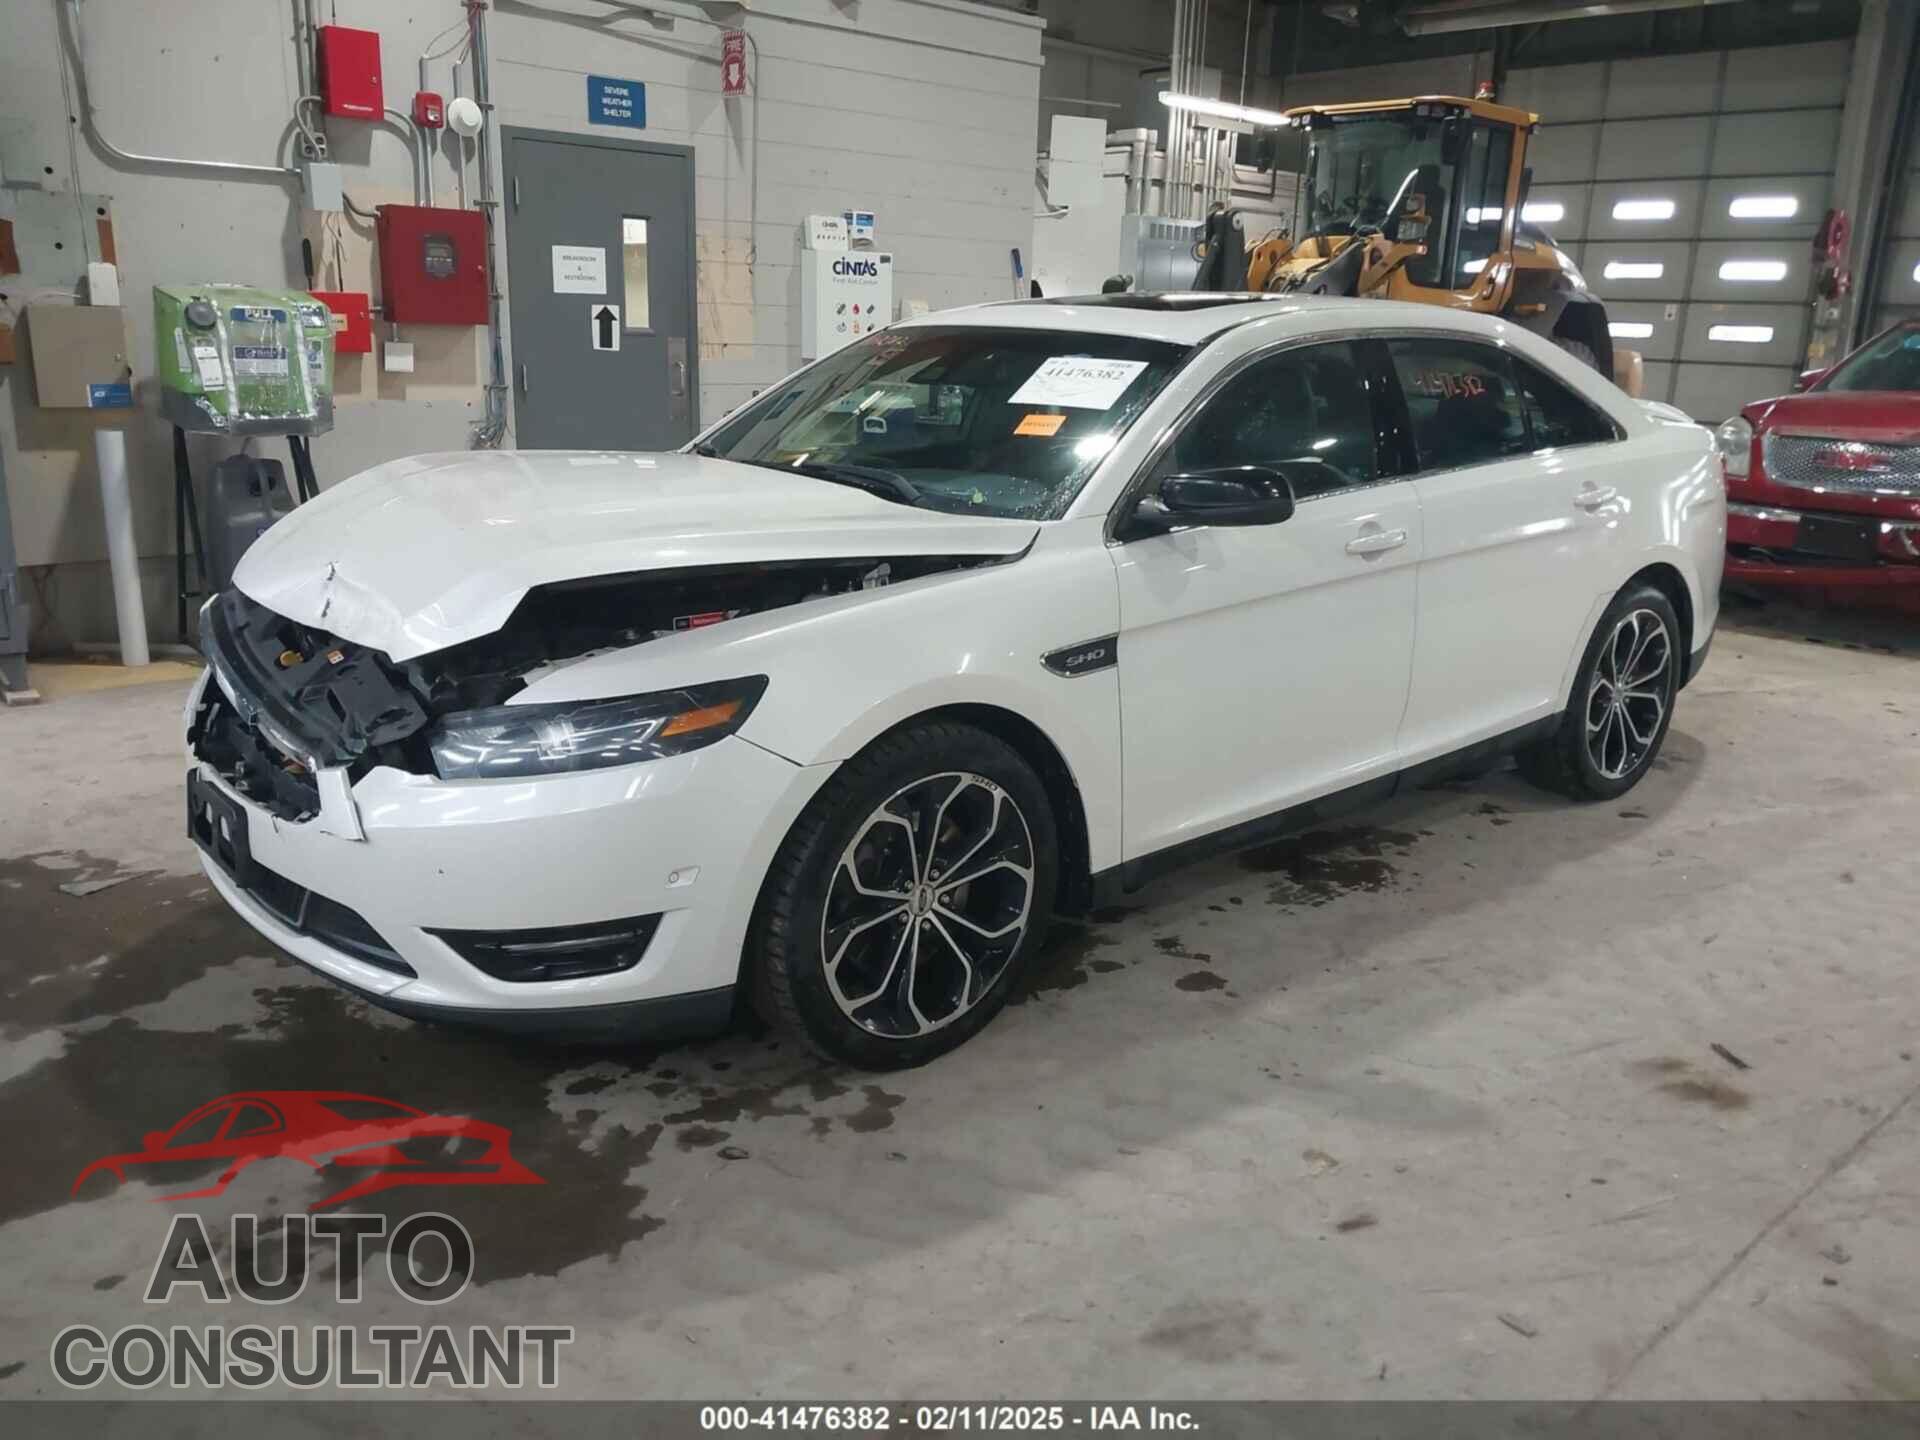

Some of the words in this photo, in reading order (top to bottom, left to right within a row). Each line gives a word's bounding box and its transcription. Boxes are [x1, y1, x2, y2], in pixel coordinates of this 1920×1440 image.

[603, 86, 630, 96] SEVERE
[602, 97, 633, 107] WEATHER
[603, 108, 632, 118] SHELTER
[832, 256, 878, 277] CINTAS
[1044, 367, 1126, 381] 41476382
[1065, 648, 1105, 667] SHO
